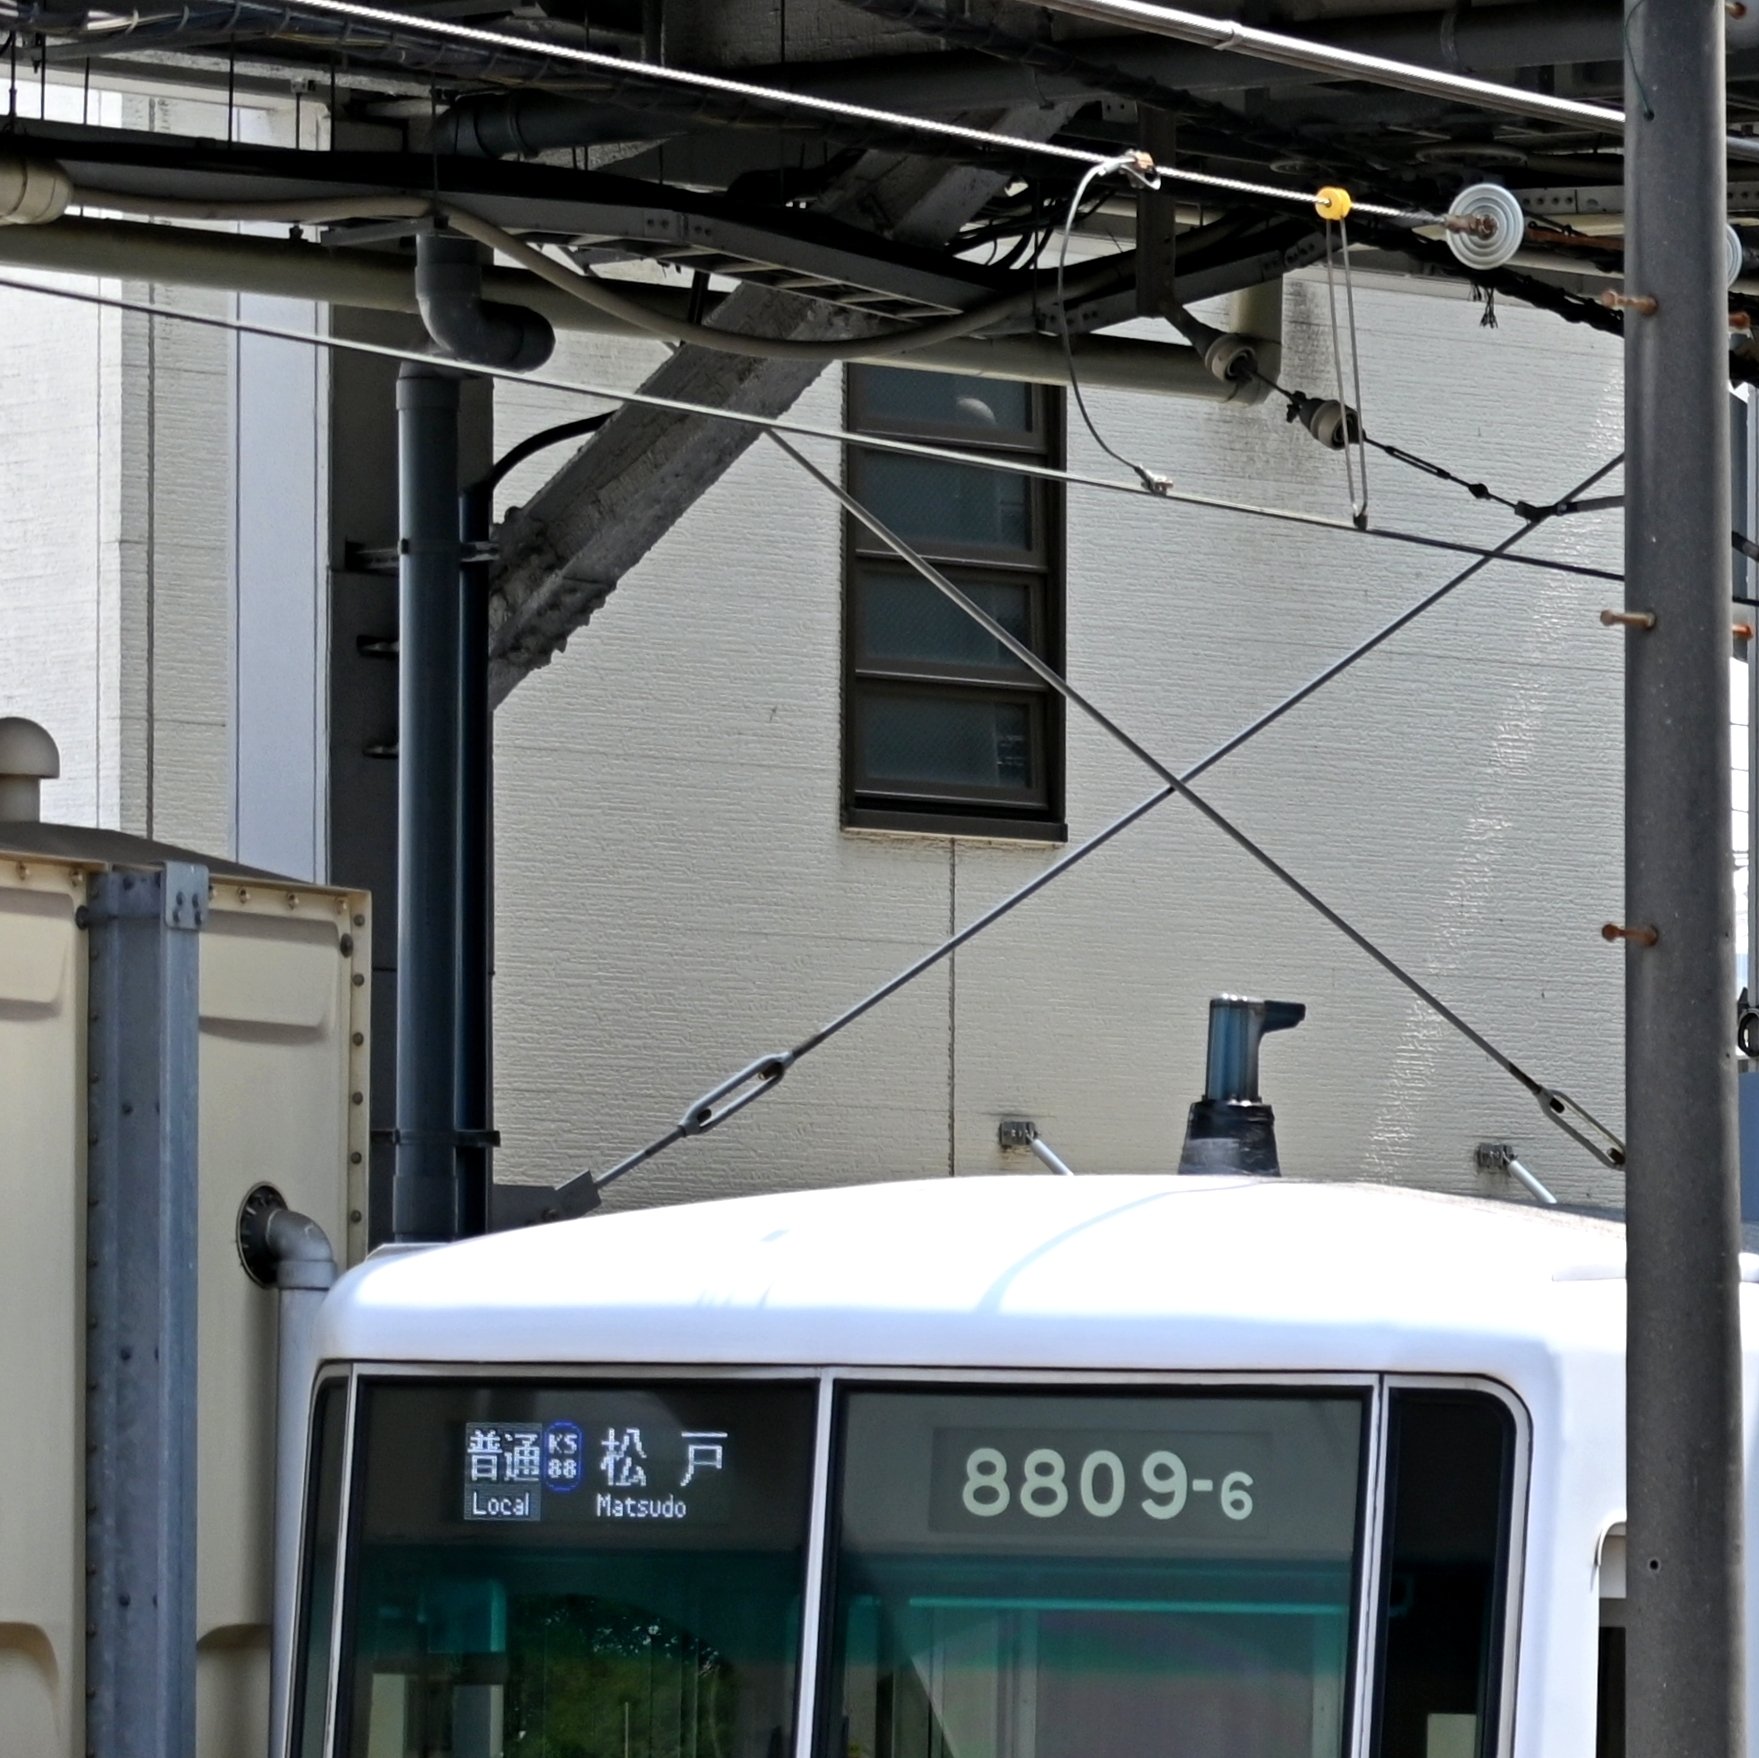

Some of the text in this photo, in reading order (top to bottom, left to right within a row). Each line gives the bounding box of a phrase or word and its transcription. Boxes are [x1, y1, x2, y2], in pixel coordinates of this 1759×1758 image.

[467, 1427, 728, 1487] 普通 松戸
[548, 1432, 578, 1455] KS
[547, 1458, 578, 1479] 88
[962, 1447, 1254, 1520] 8809-6
[472, 1491, 687, 1518] Local Matsudo
